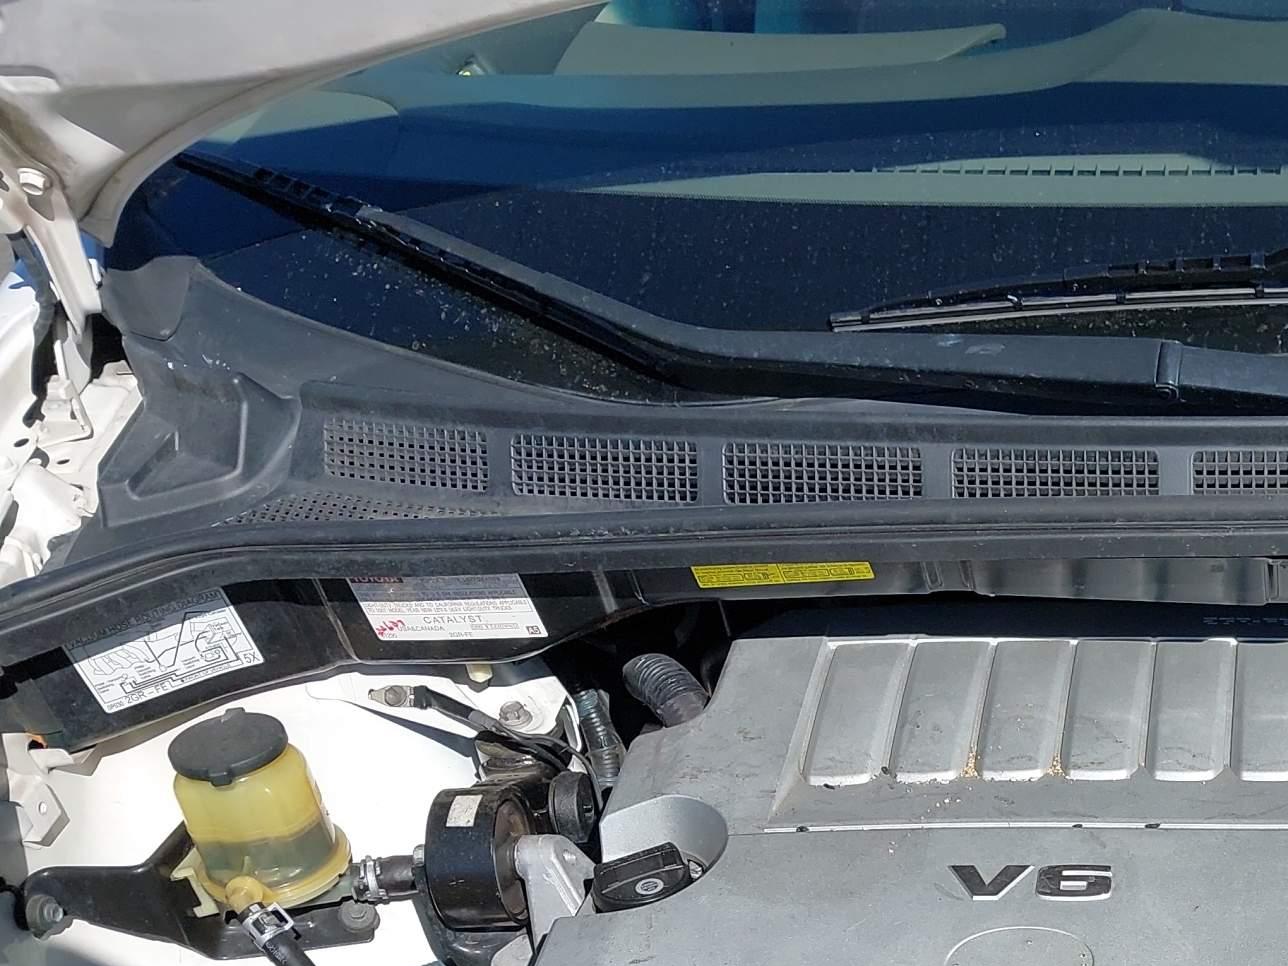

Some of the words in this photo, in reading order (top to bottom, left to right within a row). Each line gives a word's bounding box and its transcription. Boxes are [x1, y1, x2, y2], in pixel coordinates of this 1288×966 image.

[423, 615, 483, 624] CATALYST
[244, 651, 260, 664] 5X
[948, 864, 1112, 901] V6
